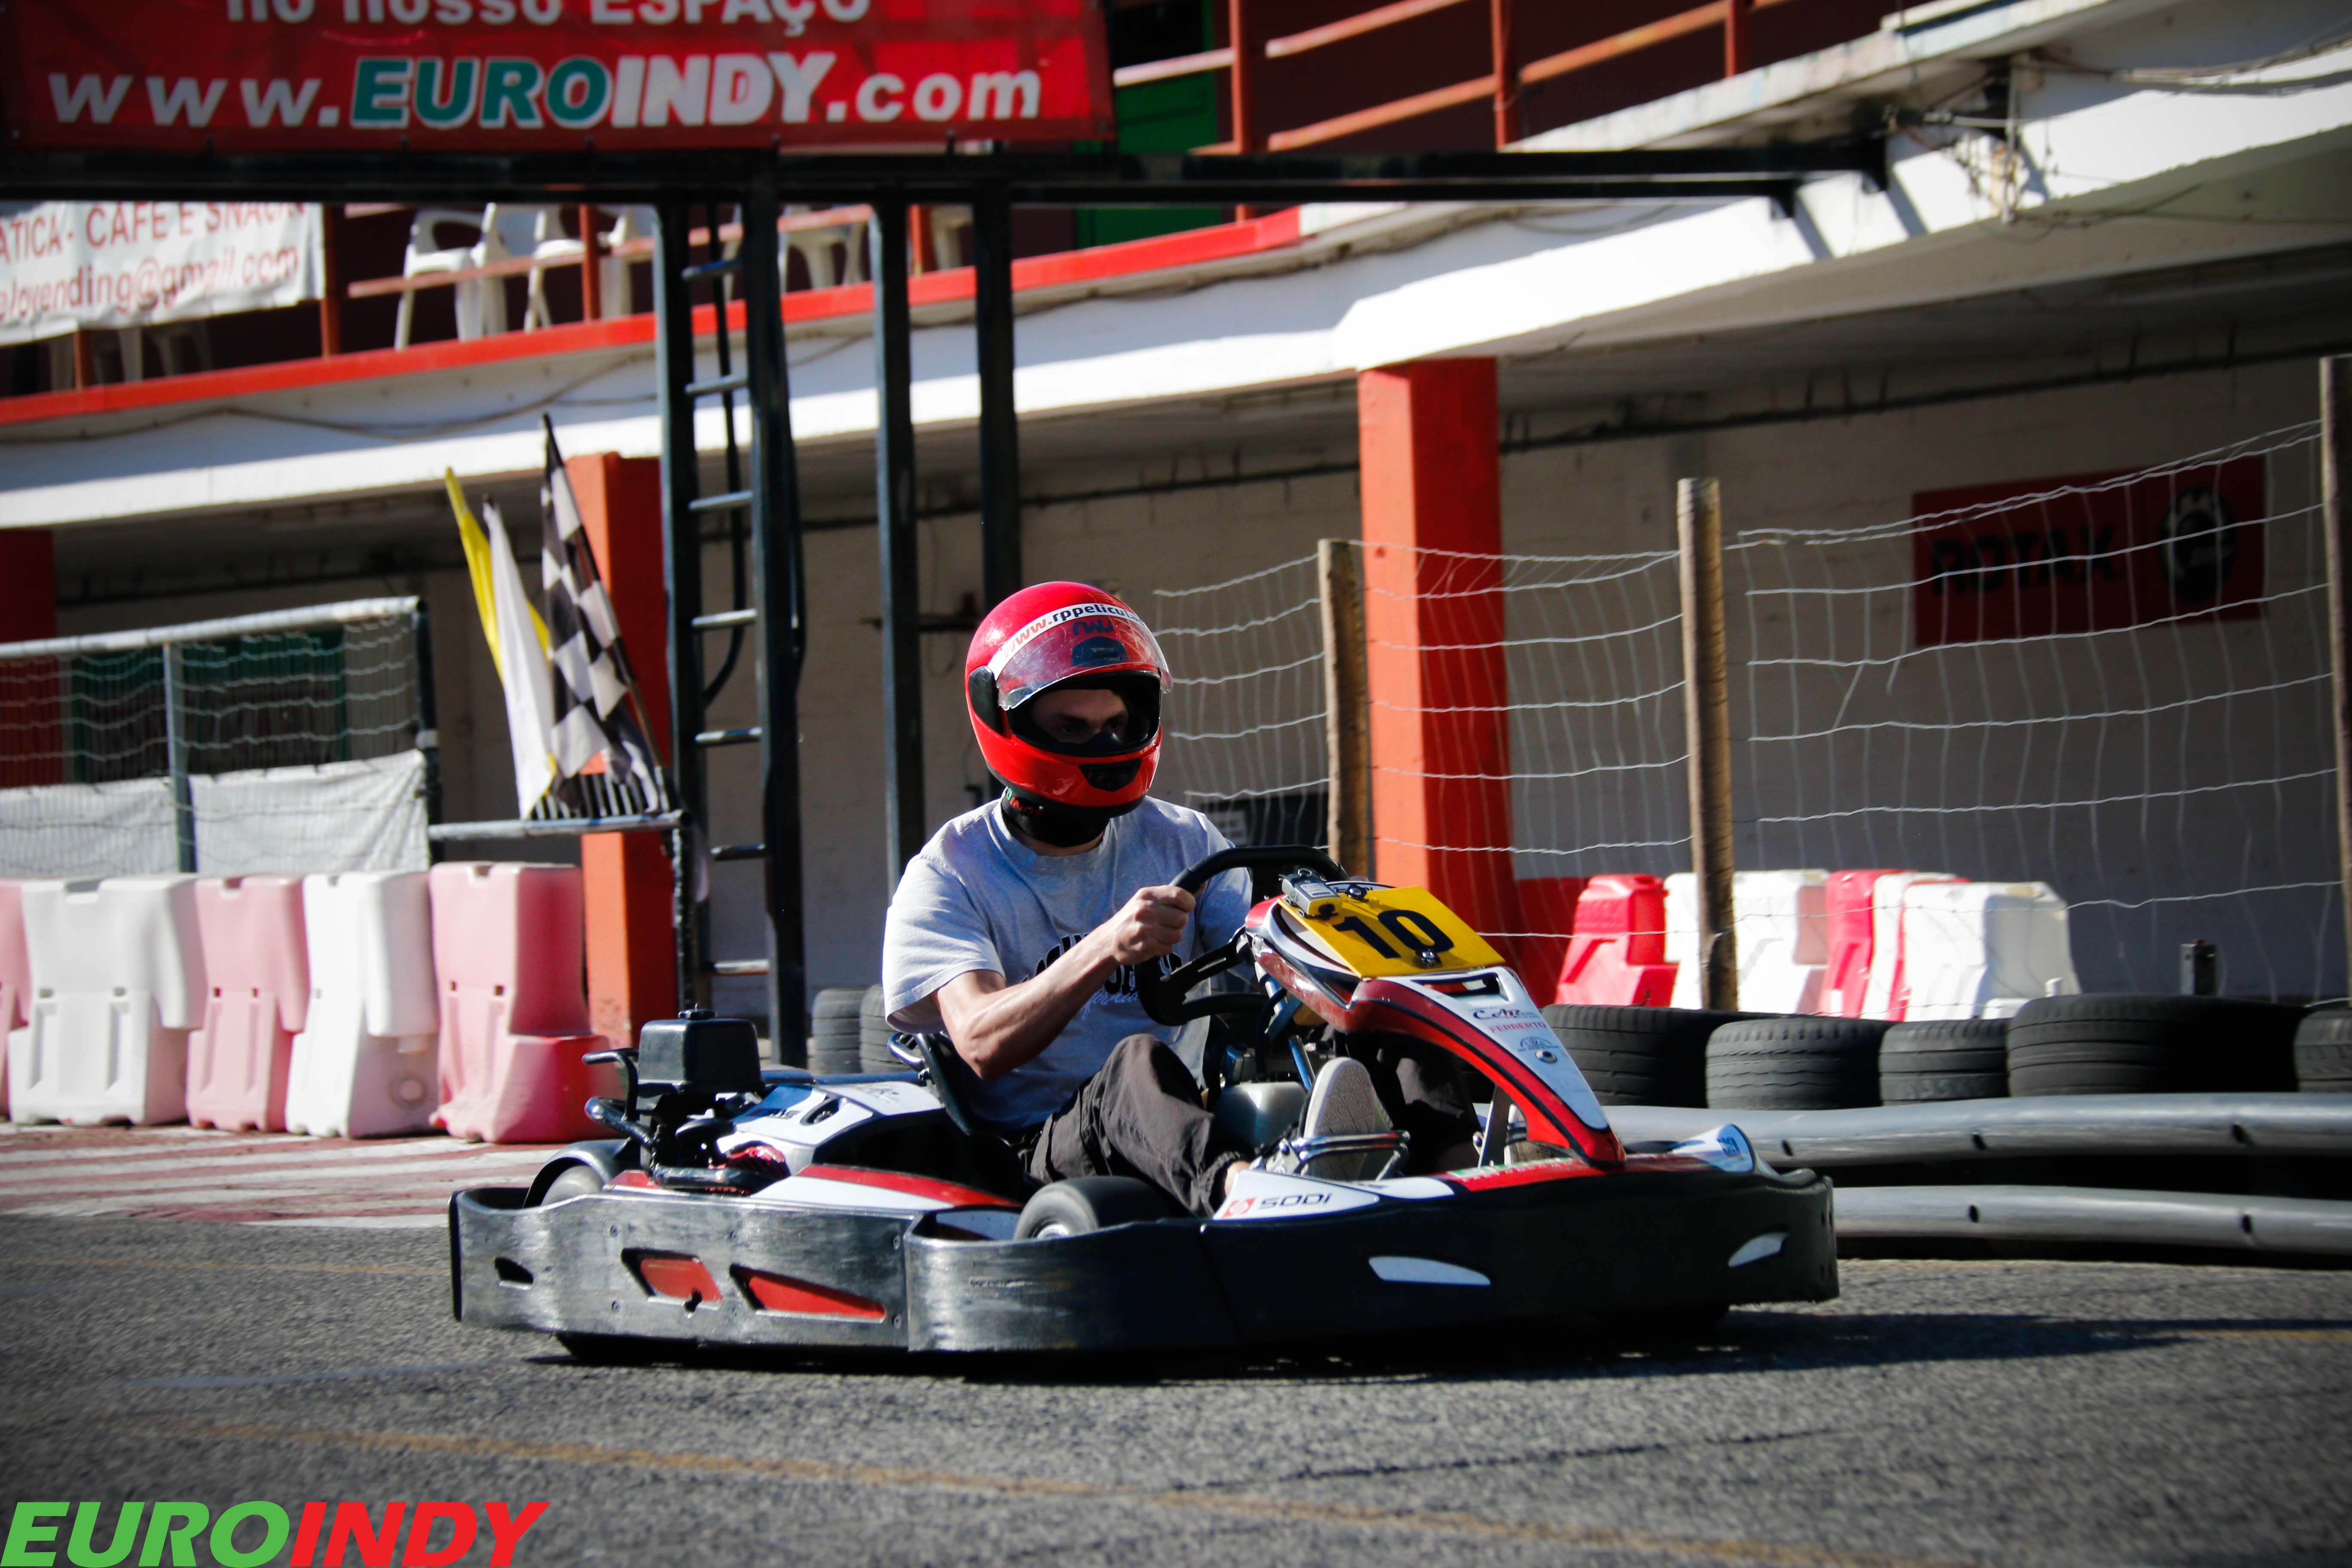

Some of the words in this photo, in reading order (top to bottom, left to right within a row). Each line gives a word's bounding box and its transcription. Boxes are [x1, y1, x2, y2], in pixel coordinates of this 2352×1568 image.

[343, 0, 561, 25] nosso
[590, 0, 870, 37] ESPAÇO
[49, 52, 1042, 129] www.EUROINDY.com
[178, 201, 195, 236] E
[1933, 523, 2116, 596] ROTAX
[1332, 909, 1455, 959] 10
